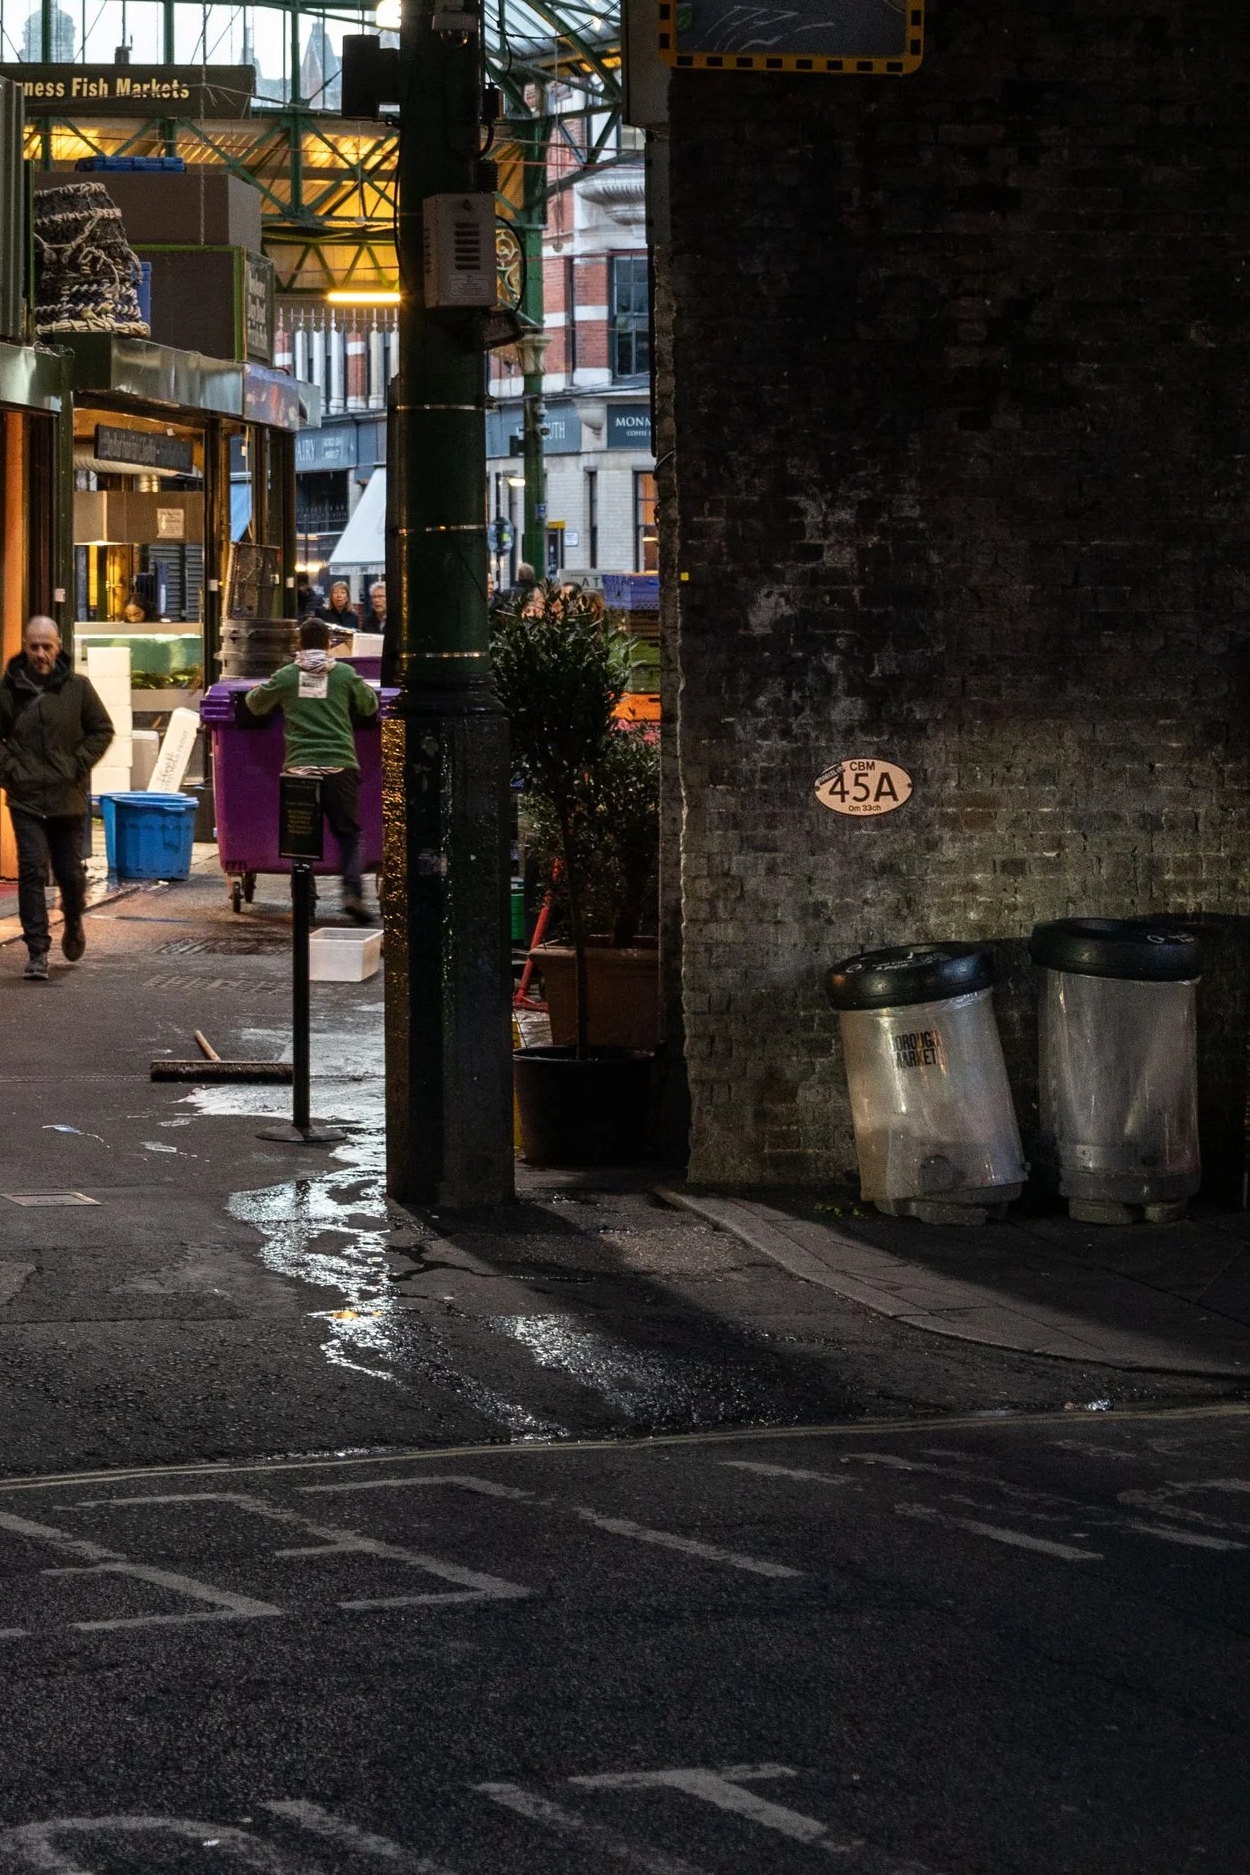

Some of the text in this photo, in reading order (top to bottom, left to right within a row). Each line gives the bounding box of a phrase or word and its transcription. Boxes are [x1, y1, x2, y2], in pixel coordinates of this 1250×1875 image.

[16, 77, 190, 99] ness Fish Markets
[849, 761, 876, 771] CBM
[828, 772, 899, 803] 45A
[862, 804, 882, 812] 33ch
